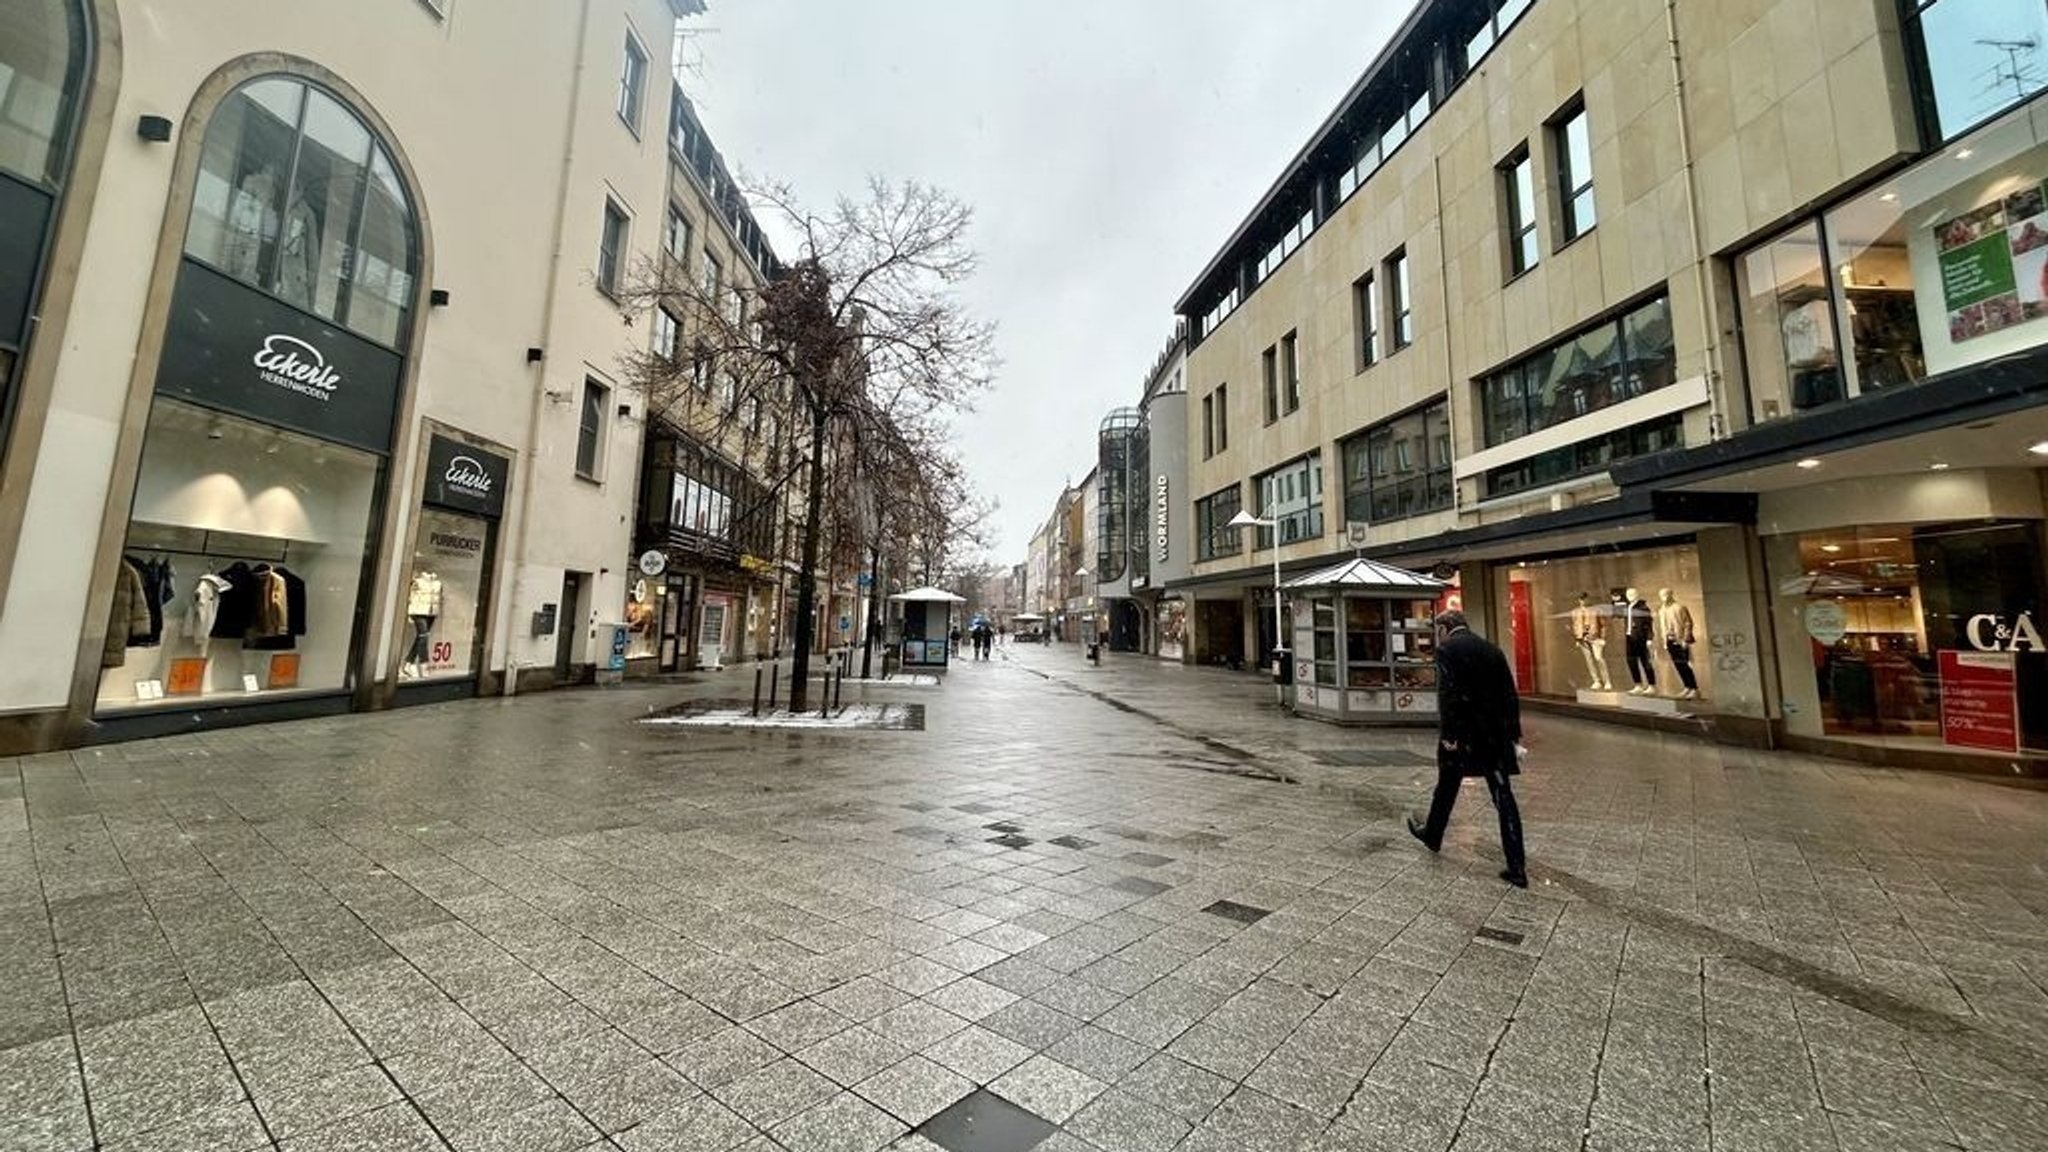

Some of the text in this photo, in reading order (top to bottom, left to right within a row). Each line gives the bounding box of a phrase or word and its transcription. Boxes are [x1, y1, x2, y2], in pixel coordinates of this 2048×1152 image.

[254, 334, 340, 389] Eckerle
[260, 370, 329, 401] HERRENMODEN
[445, 456, 491, 491] Eckerle
[1157, 475, 1168, 562] WORMLAND
[1966, 613, 2046, 652] C&A
[432, 642, 451, 662] 50
